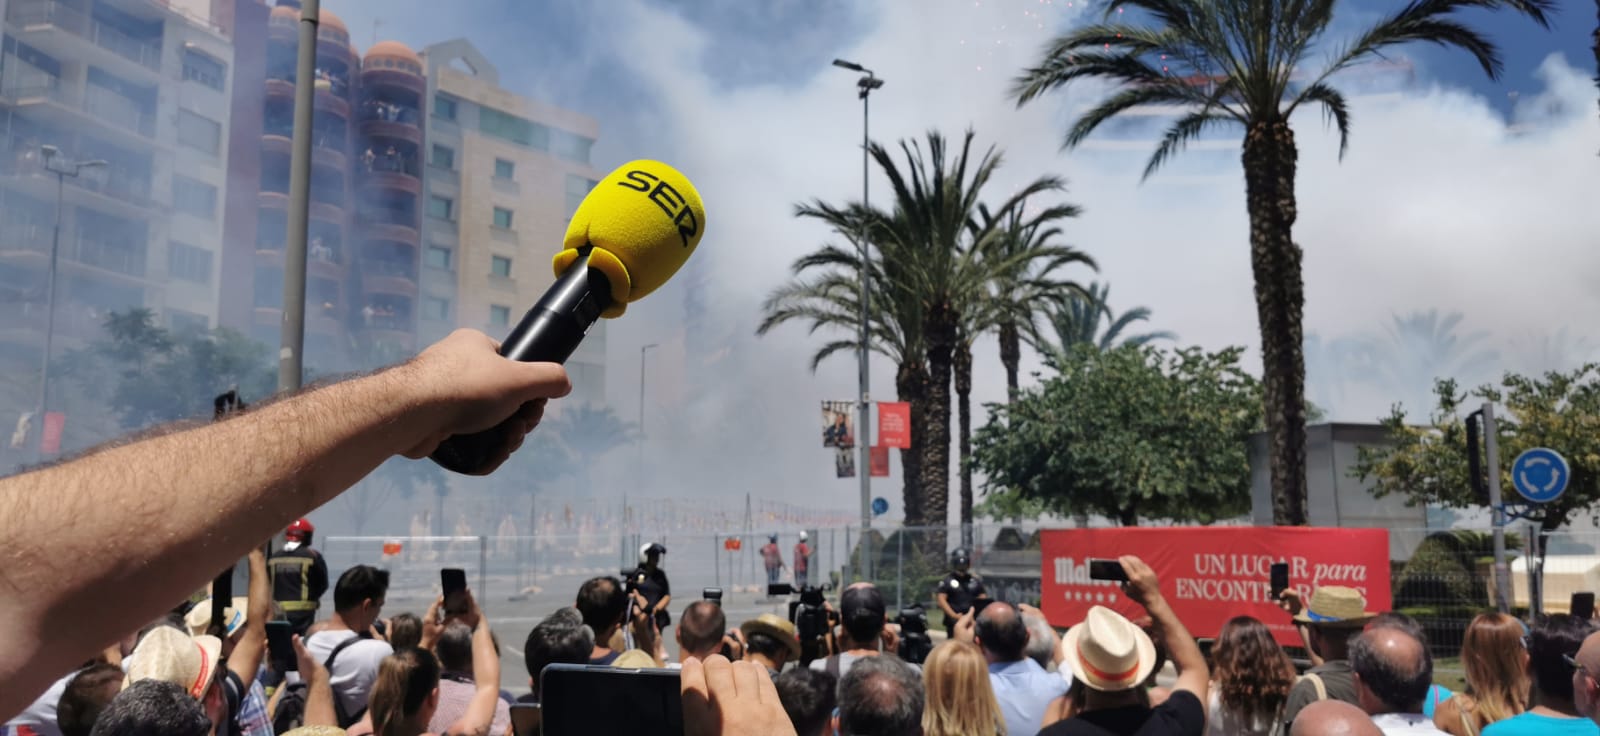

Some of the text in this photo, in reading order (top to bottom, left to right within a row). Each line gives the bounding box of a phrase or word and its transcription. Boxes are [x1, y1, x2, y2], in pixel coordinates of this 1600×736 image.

[618, 170, 697, 248] SER
[1193, 554, 1227, 575] UN
[1312, 562, 1367, 591] para
[1175, 578, 1367, 609] ENCONTR
